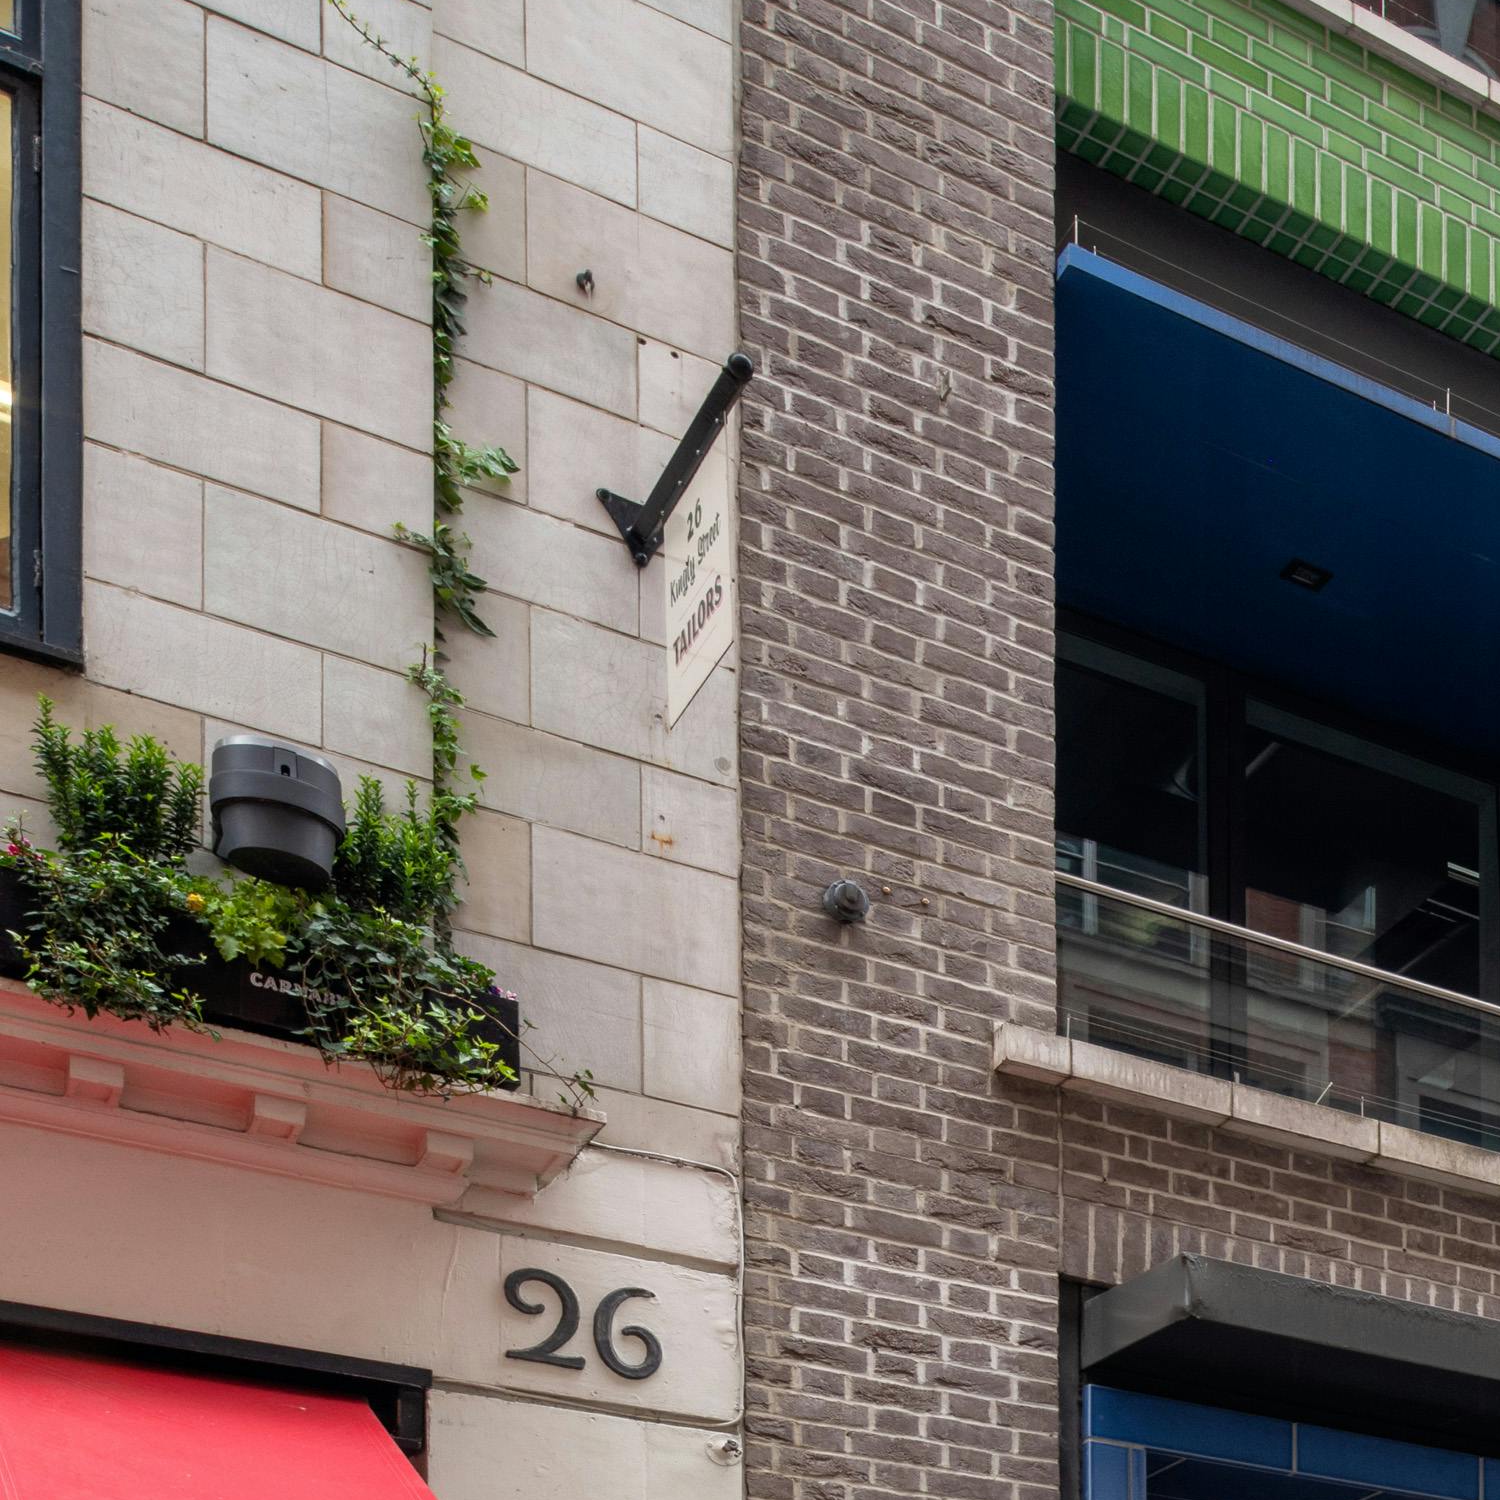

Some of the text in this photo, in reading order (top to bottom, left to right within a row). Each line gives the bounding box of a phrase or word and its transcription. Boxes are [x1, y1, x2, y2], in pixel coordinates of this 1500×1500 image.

[686, 498, 702, 543] 26
[672, 574, 723, 668] TAILORS
[504, 1267, 663, 1380] 26
